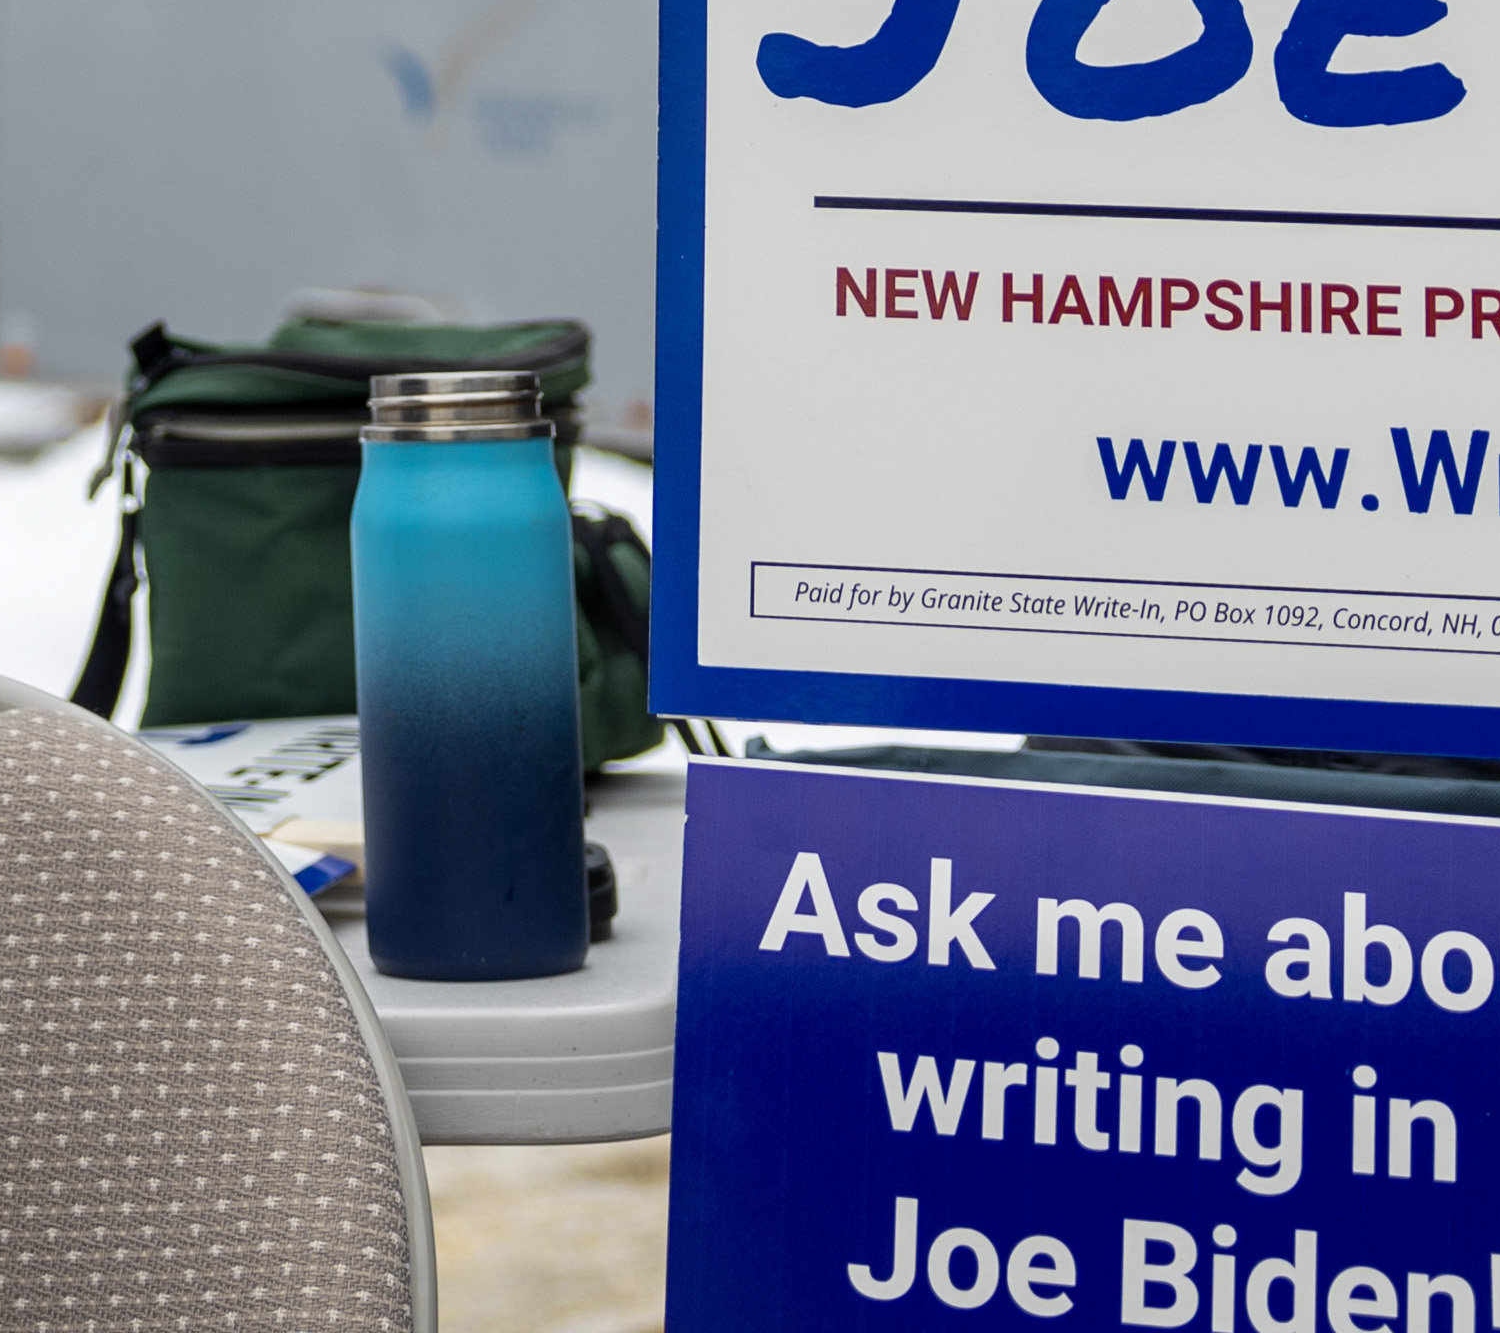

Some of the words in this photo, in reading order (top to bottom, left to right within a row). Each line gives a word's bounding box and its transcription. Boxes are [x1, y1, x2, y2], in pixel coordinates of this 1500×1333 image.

[835, 266, 980, 321] NEW
[1002, 272, 1402, 337] HAMPSHIRE
[793, 580, 844, 608] Paid
[846, 581, 884, 612] for
[887, 584, 915, 614] by
[921, 587, 1003, 613] Granite
[1009, 592, 1066, 616] State
[1074, 595, 1165, 624] Write-In,
[1174, 600, 1207, 623] PO
[1214, 602, 1256, 625] Box
[1265, 604, 1323, 631] 1092,
[1332, 607, 1433, 637] Concord,
[1441, 612, 1482, 639] NH,
[758, 851, 997, 971] Ask
[1035, 896, 1225, 989] me
[876, 1037, 1304, 1196] writing
[1352, 1064, 1457, 1183] in
[847, 1196, 1077, 1318] Joe
